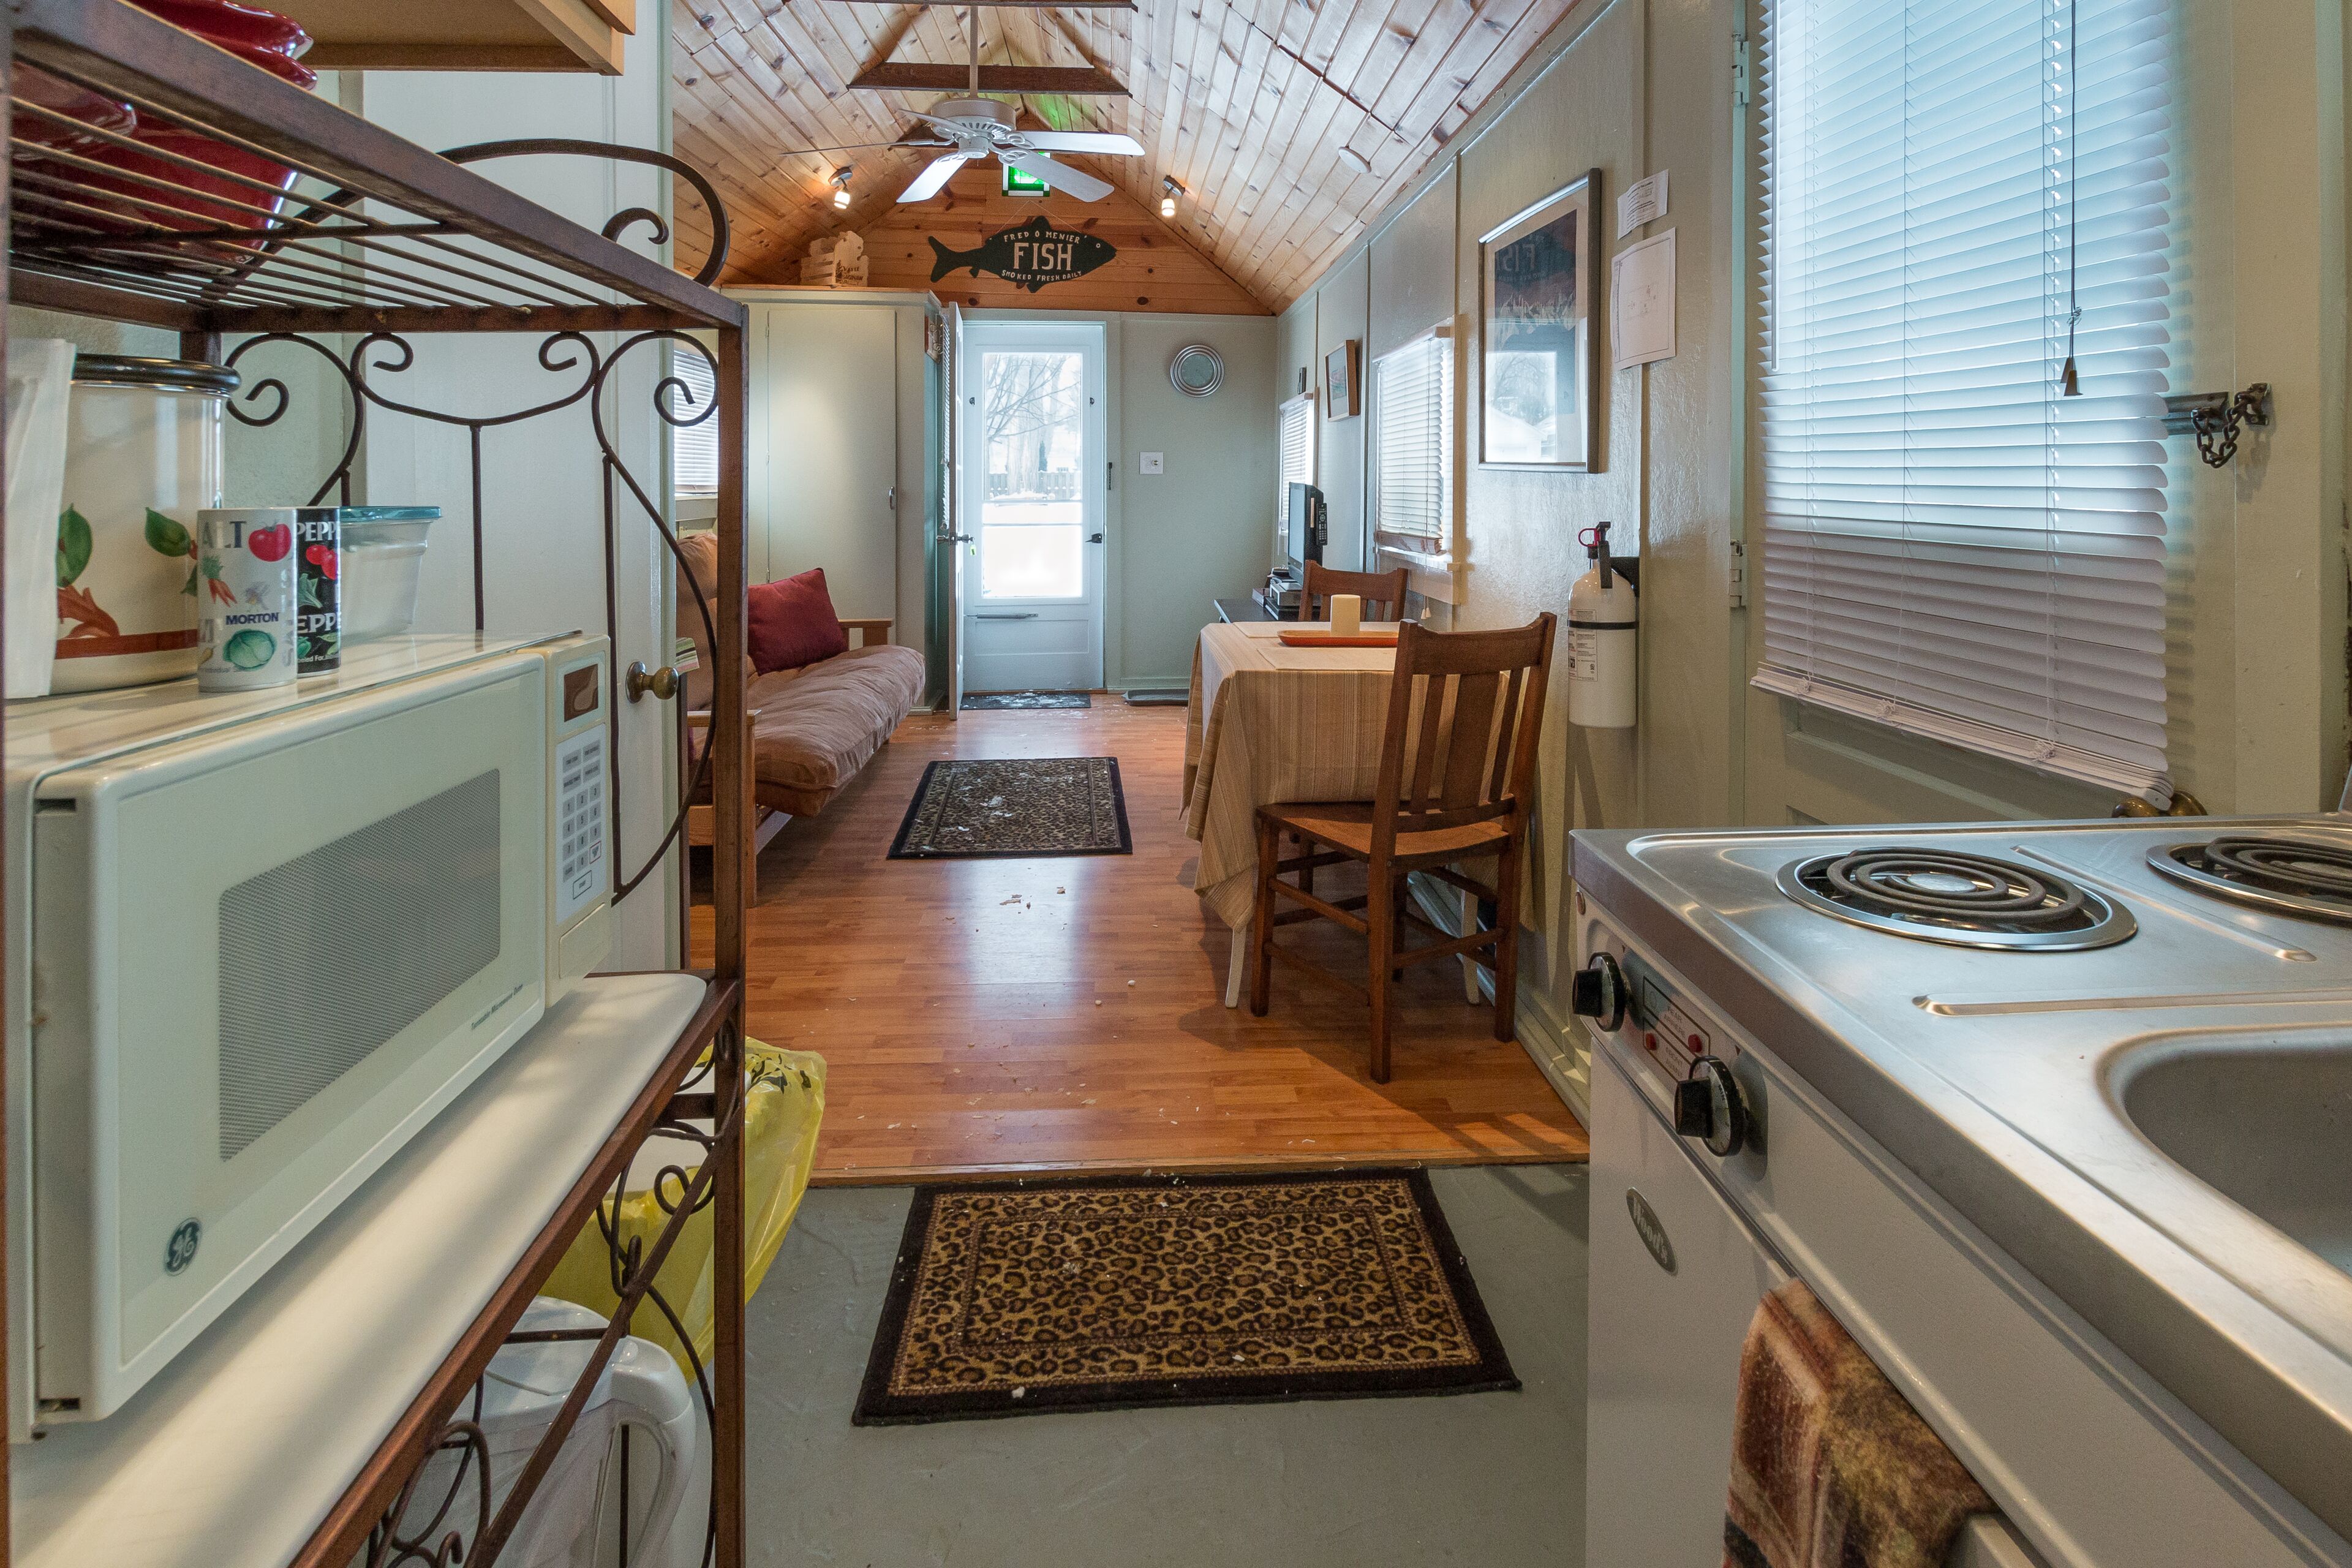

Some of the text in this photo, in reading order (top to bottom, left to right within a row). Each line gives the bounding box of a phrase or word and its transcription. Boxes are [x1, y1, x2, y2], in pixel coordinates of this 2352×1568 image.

[1004, 232, 1029, 242] FRED
[1045, 231, 1080, 244] MENIER
[1013, 242, 1073, 270] FISH
[1001, 270, 1031, 280] SMOKED
[1062, 271, 1082, 279] DAILY
[225, 612, 280, 625] MORTON
[1632, 1197, 1668, 1264] Wood's
